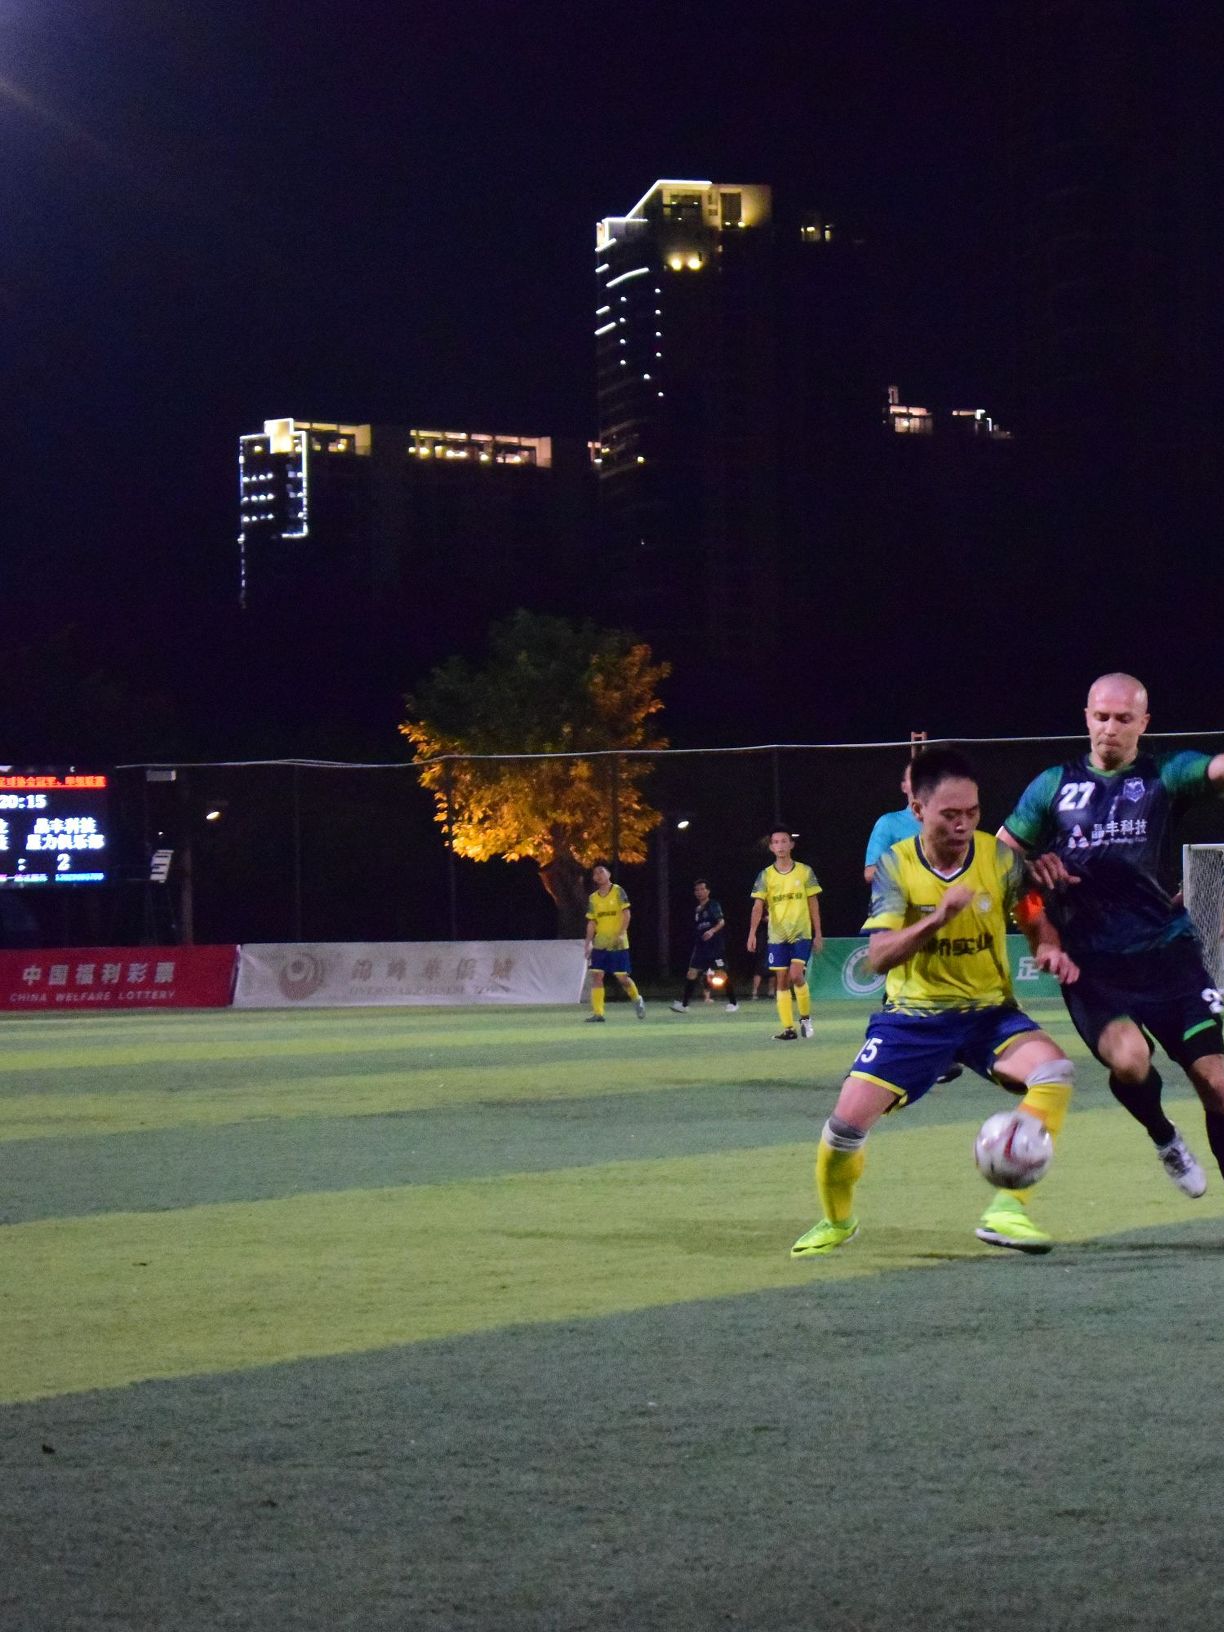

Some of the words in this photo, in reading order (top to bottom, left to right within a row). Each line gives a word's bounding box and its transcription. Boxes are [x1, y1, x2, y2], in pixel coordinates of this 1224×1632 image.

[1059, 781, 1095, 811] 27
[57, 853, 70, 871] 2
[22, 962, 176, 986] 中国福利彩票
[118, 990, 176, 1000] LOTTERY
